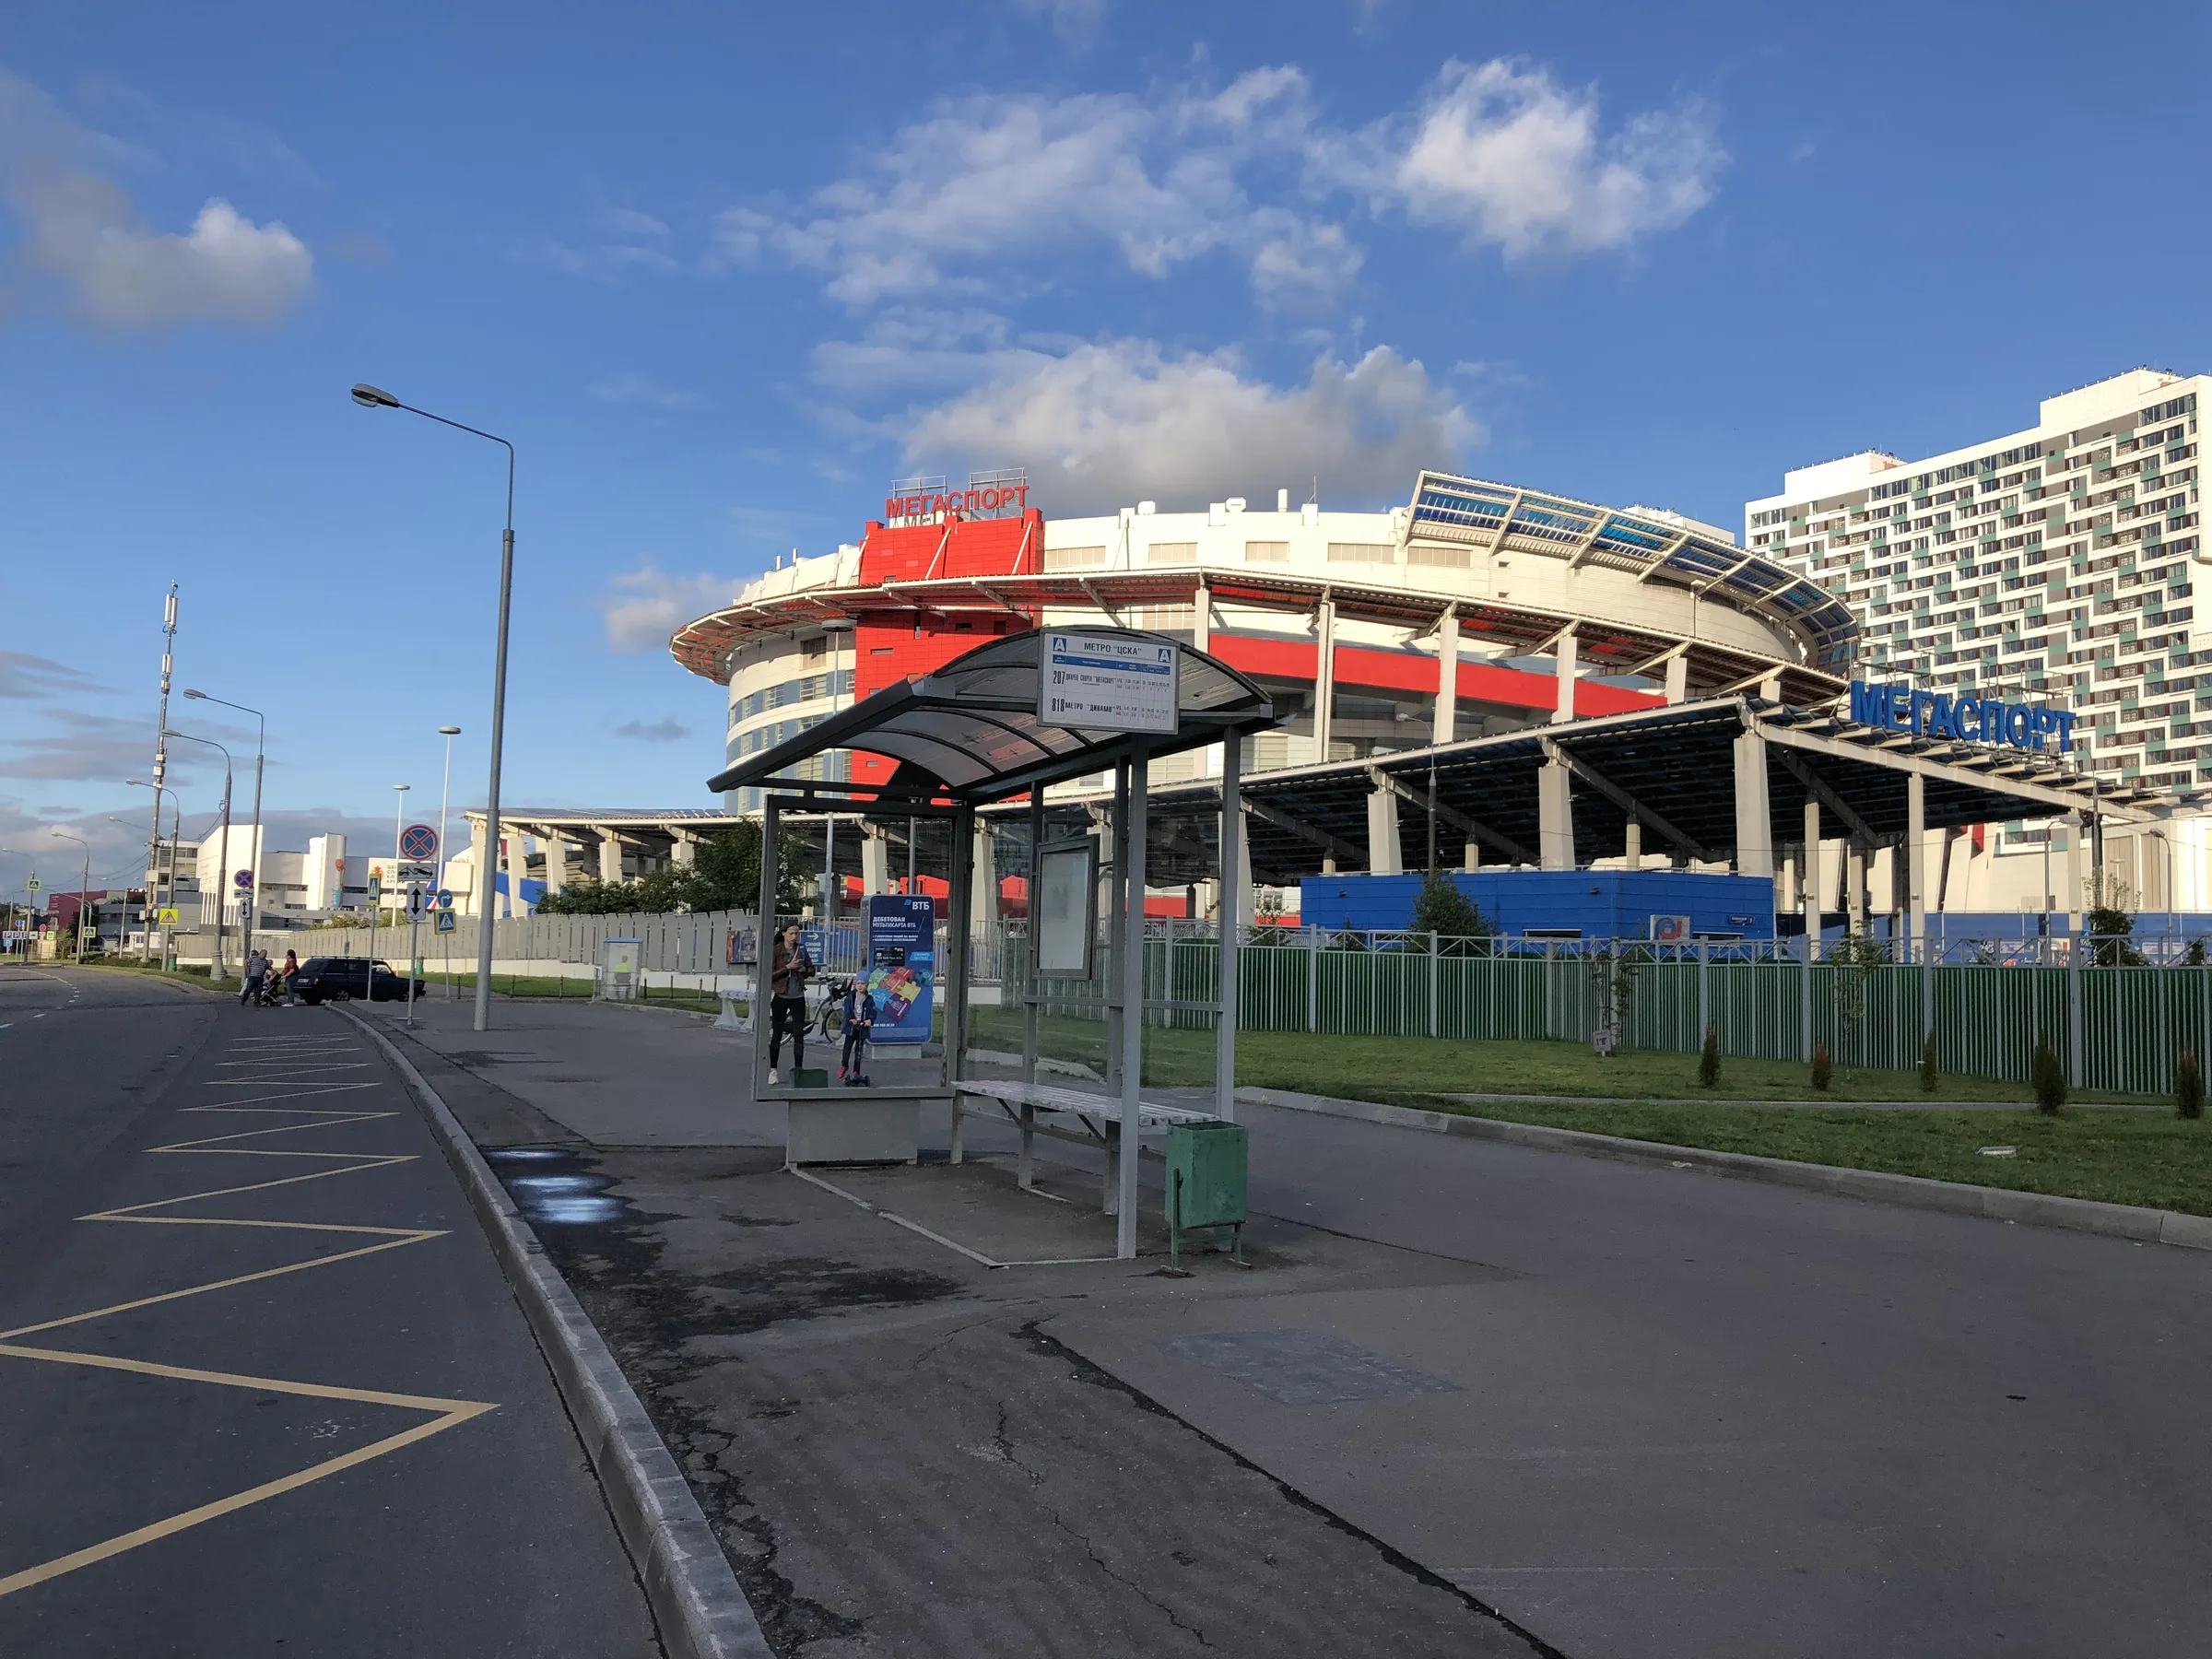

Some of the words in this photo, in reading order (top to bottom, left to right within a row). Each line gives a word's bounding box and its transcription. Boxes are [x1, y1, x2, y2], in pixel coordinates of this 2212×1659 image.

[886, 486, 1030, 518] МЕГАСПОРТ
[1084, 642, 1112, 653] МЕТРО
[1113, 646, 1142, 655] "ЦСКА"
[1053, 670, 1065, 684] 207
[1052, 698, 1065, 712] 818
[1851, 680, 2077, 752] МЕГАСПОРТ
[912, 901, 930, 911] ВТБ
